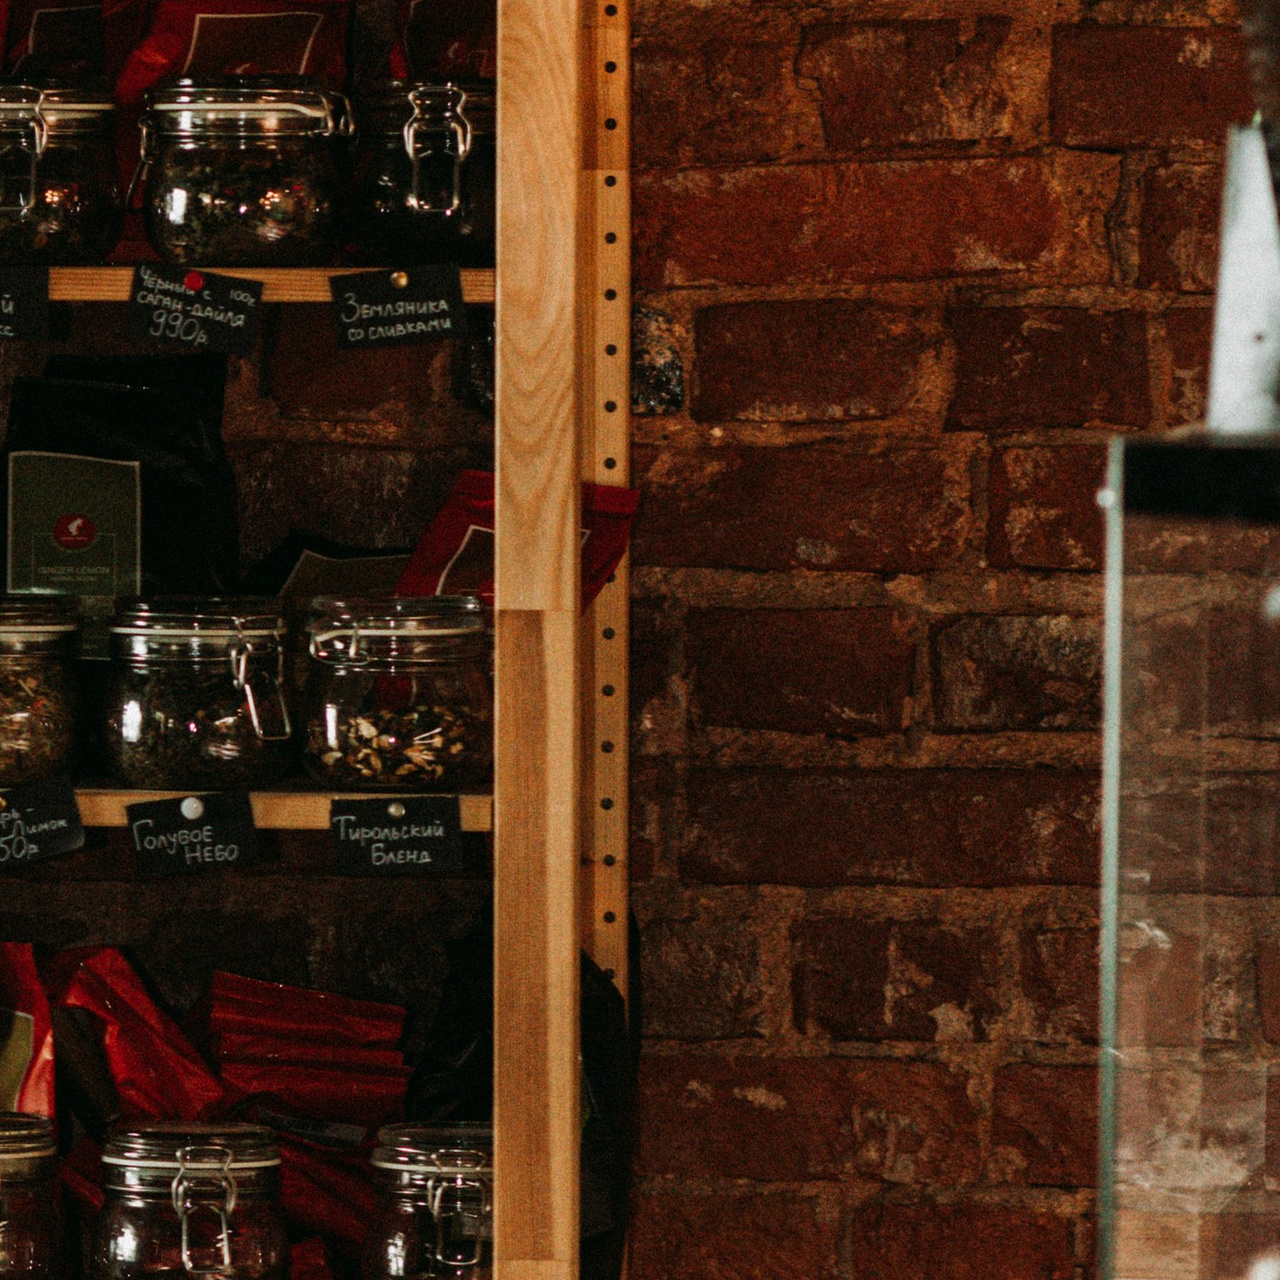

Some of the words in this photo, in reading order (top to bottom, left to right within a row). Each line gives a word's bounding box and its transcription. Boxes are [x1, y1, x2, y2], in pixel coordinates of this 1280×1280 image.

[341, 293, 449, 322] Земляника
[132, 819, 213, 854] Голубое
[332, 816, 444, 846] Тирольский
[371, 843, 432, 865] Бленд
